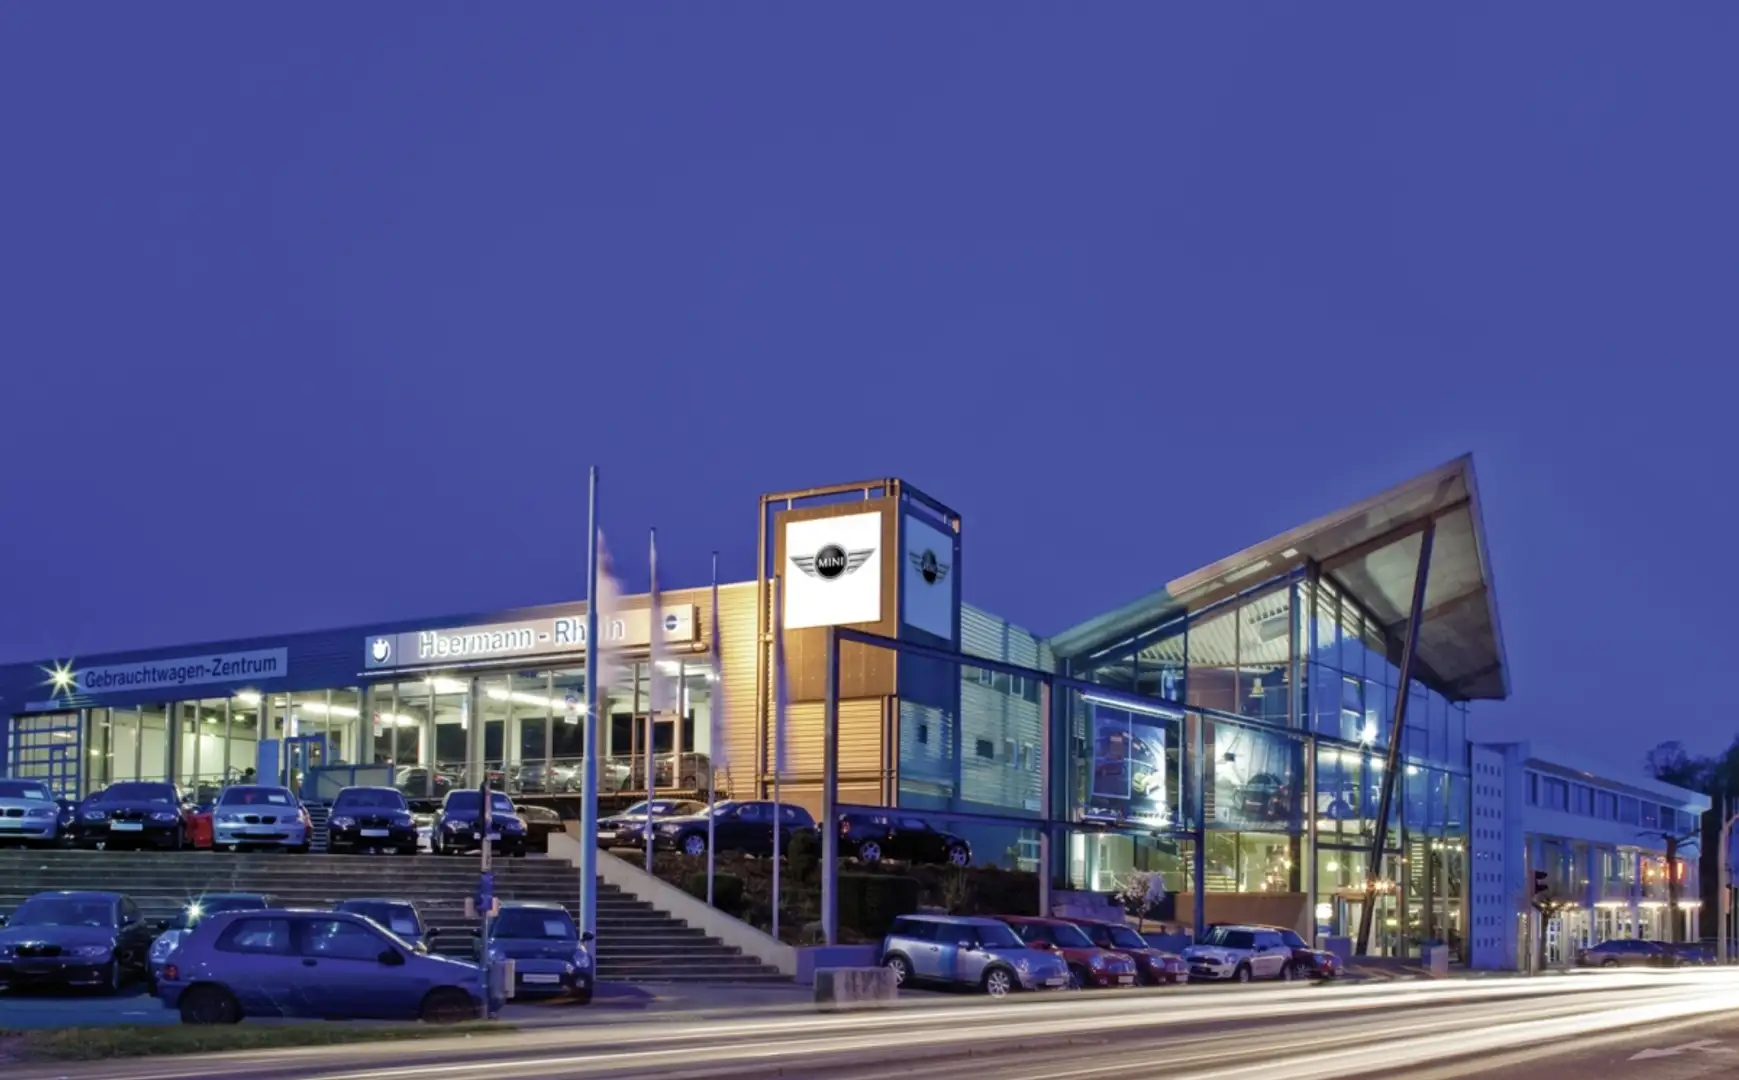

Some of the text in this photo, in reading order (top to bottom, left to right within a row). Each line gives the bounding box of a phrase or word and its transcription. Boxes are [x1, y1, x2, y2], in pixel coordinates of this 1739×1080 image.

[818, 557, 844, 568] MINI
[419, 628, 535, 658] Heermann
[554, 617, 626, 646] Rhin
[85, 657, 277, 688] Gebrauchtwagen-Zentrum
